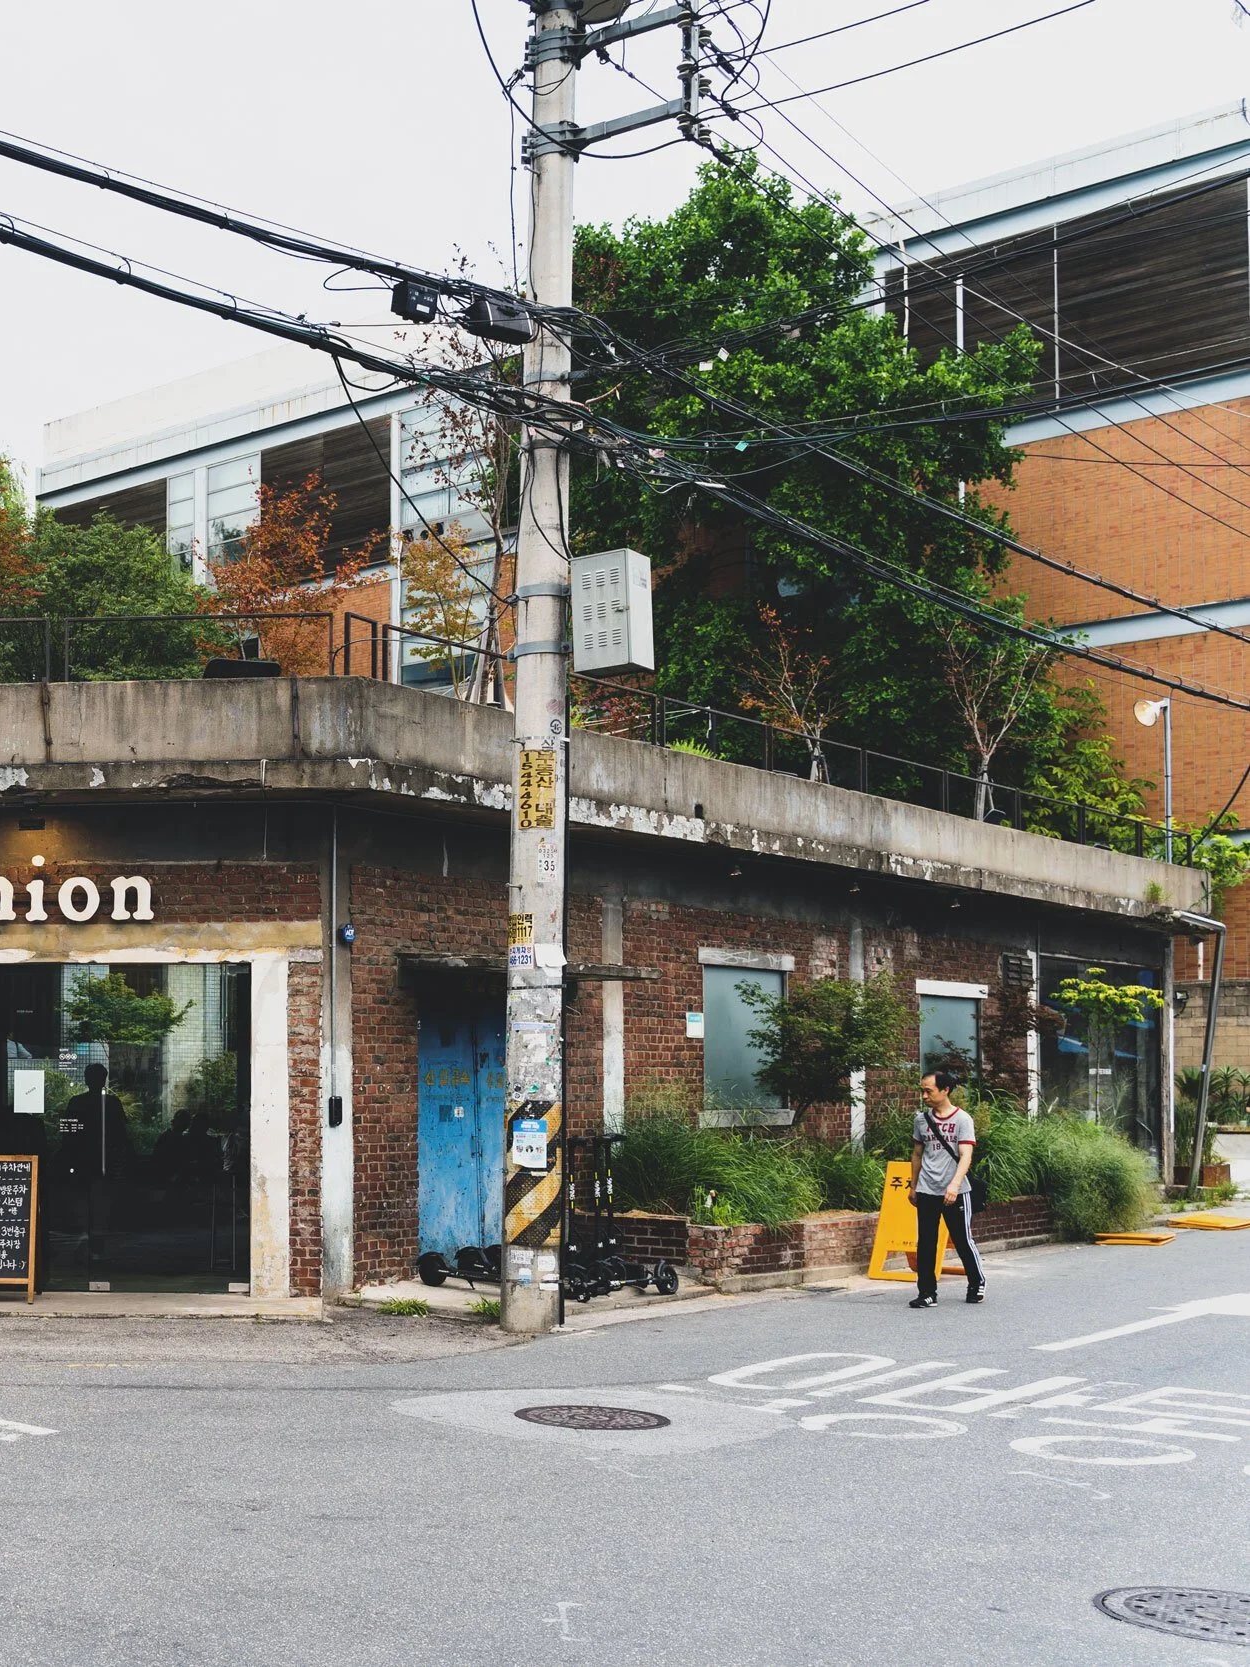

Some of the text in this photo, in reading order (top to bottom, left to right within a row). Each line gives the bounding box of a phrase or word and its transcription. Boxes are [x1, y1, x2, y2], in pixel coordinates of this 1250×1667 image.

[2, 1162, 30, 1173] 주차안내
[2, 1196, 23, 1207] 시스템
[0, 1239, 21, 1250] 주차장
